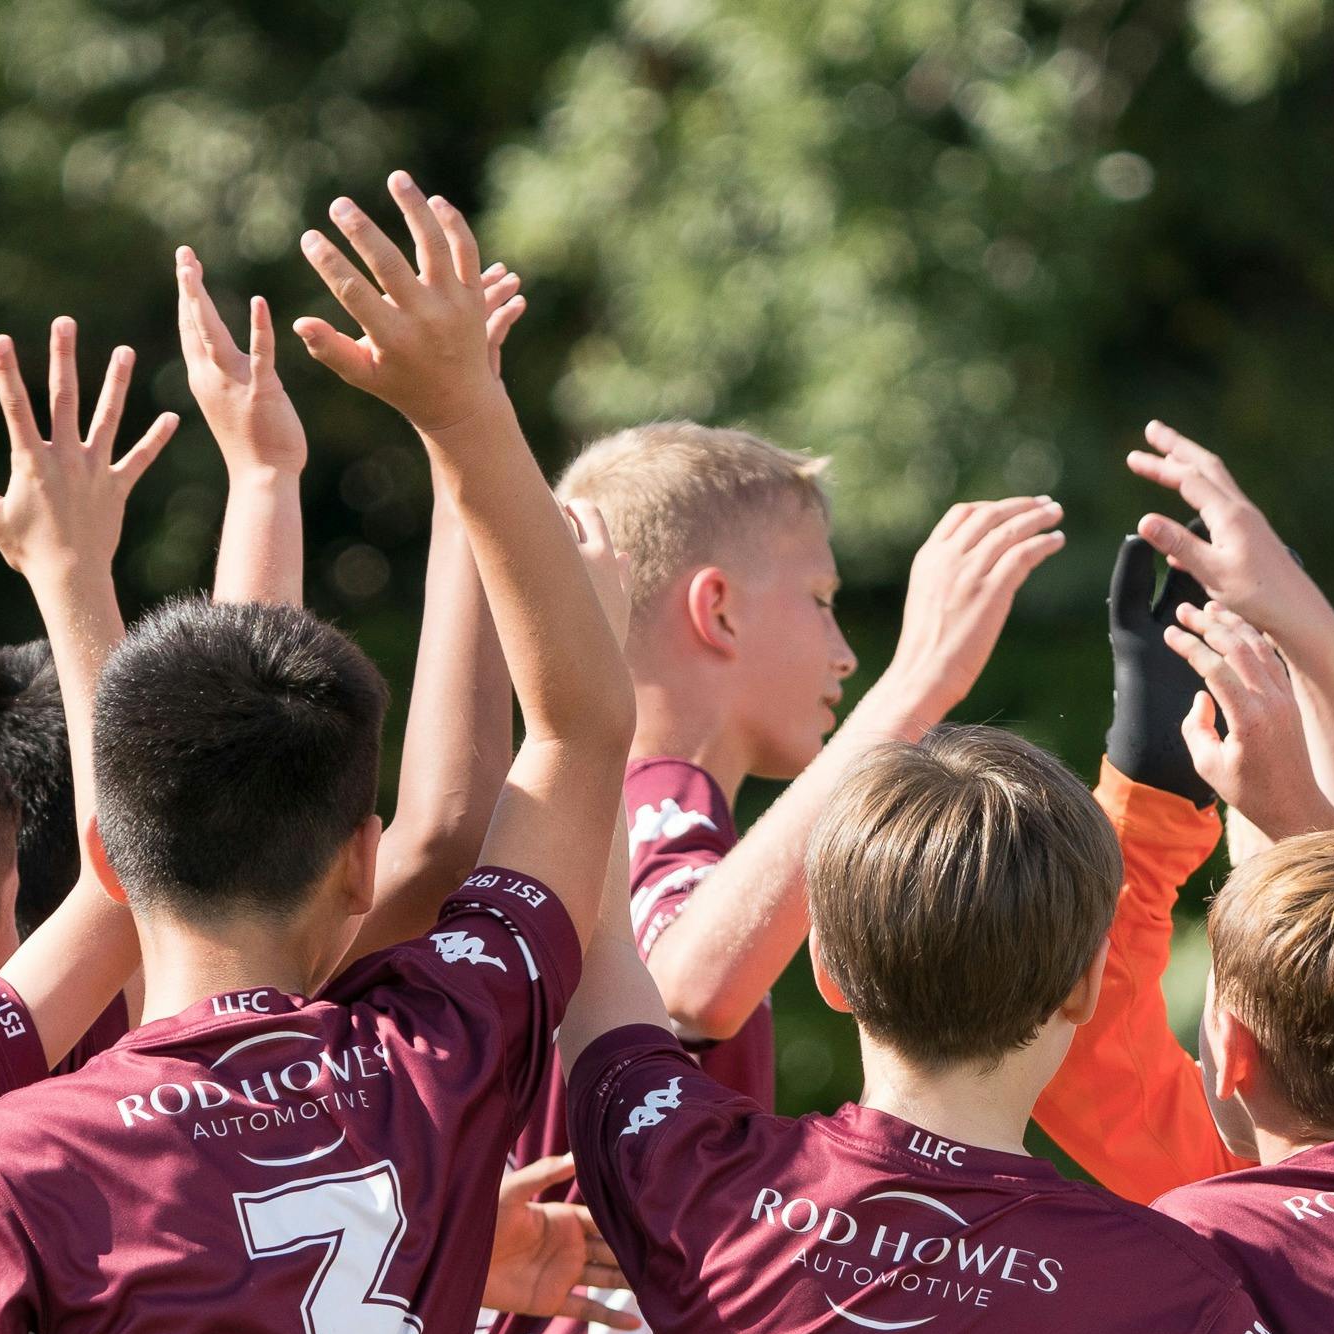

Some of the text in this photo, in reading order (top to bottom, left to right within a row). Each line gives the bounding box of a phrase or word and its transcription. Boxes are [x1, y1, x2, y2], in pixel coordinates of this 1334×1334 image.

[210, 991, 270, 1017] LLFC
[116, 1081, 231, 1129] ROD
[193, 1089, 370, 1140] AUTOMOTIVE
[907, 1131, 967, 1167] LLFC
[750, 1187, 1064, 1293] ROD HOWES
[789, 1247, 993, 1308] AUTOMOTIVE
